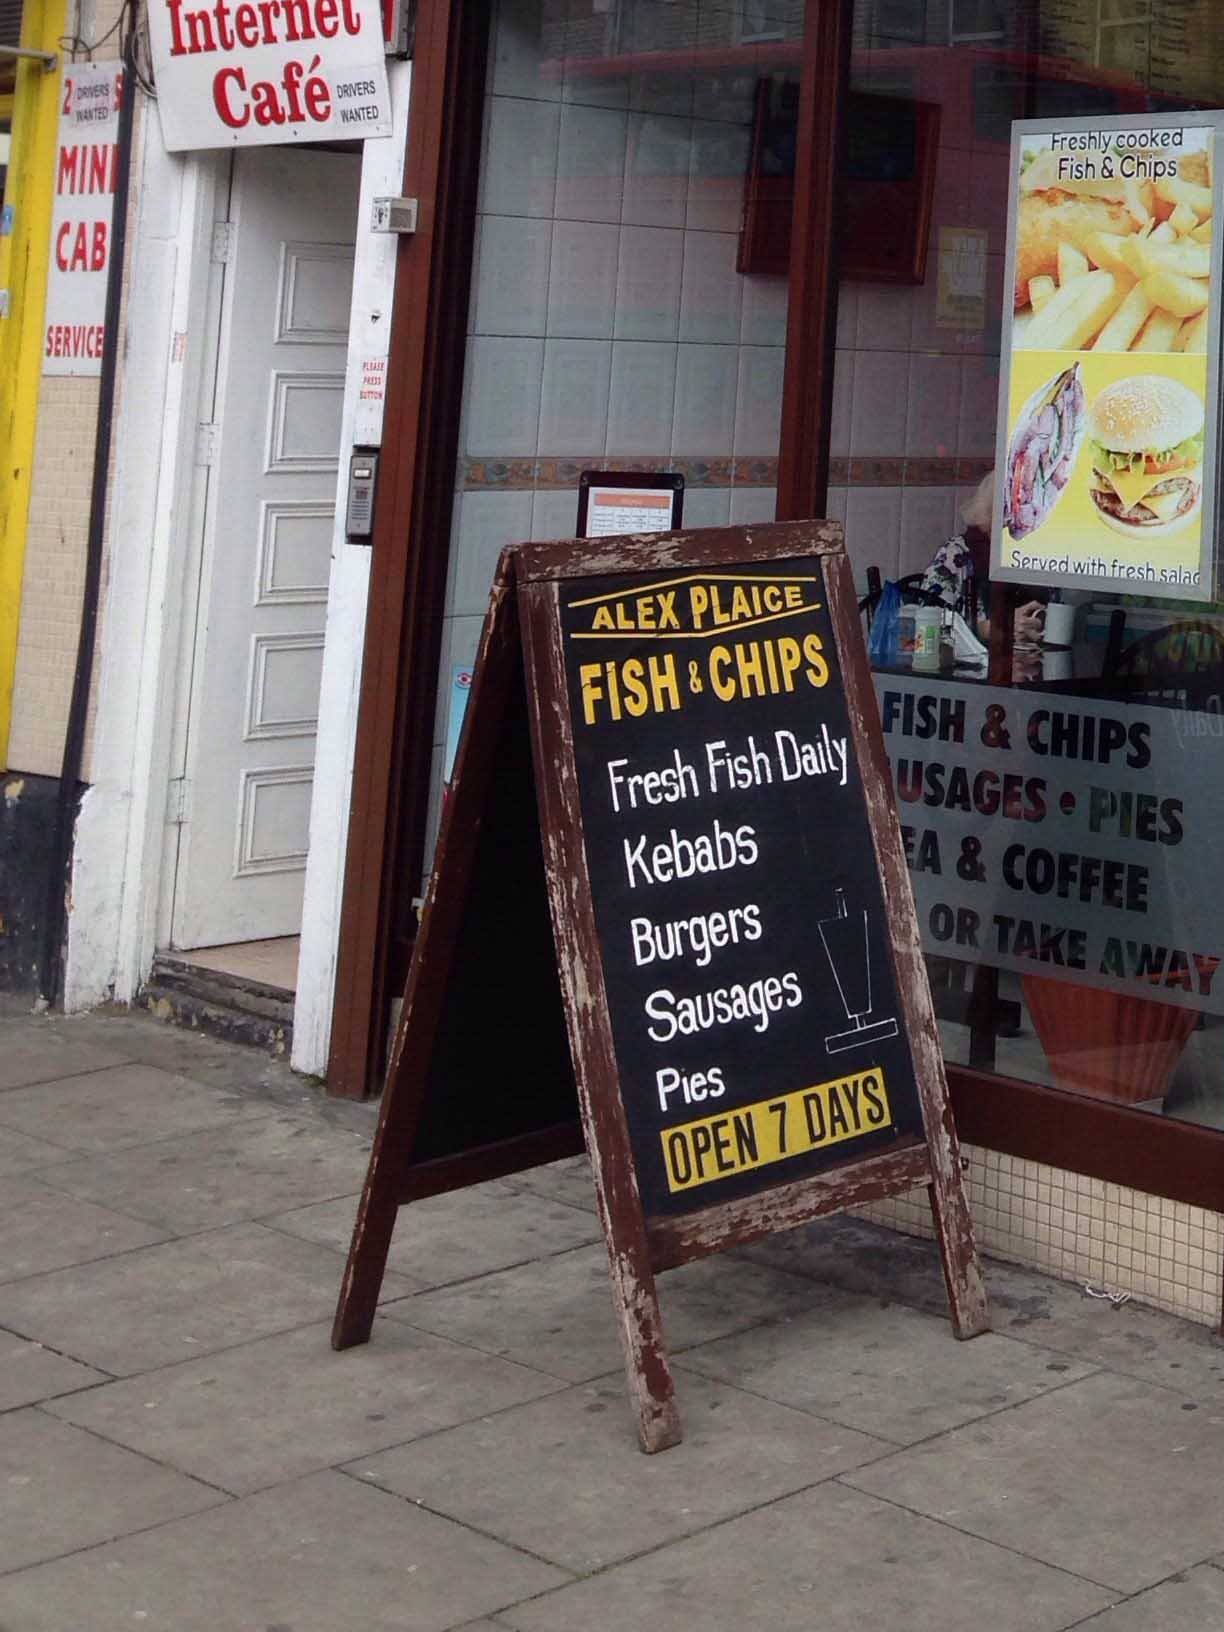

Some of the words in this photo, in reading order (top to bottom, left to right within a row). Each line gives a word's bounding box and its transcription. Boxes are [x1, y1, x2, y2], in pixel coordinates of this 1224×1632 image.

[76, 107, 109, 122] WANTED
[213, 55, 331, 128] Café
[336, 80, 376, 98] DRIVERS
[340, 107, 379, 123] WANTED
[1051, 130, 1112, 154] Freshly
[1116, 127, 1183, 148] cooked
[1058, 157, 1096, 180] Fish
[1101, 156, 1114, 179] &
[1120, 155, 1177, 182] Chips
[56, 221, 107, 272] CAB
[1011, 550, 1069, 574] Served
[1073, 556, 1106, 576] with
[1111, 559, 1156, 581] fresh
[591, 591, 681, 630] ALEX
[689, 585, 803, 629] PLAICE
[580, 654, 681, 725] FISH
[688, 660, 703, 694] &
[709, 634, 829, 702] CHIPS
[883, 691, 966, 744] FISH
[980, 703, 1012, 749] &
[1027, 709, 1151, 769] CHIPS
[608, 749, 699, 813] Fresh
[705, 735, 773, 793] Fish
[775, 724, 848, 786] Daily
[896, 758, 1047, 823] USAGES
[1088, 785, 1184, 846] PIES
[624, 819, 759, 888] Kebabs
[901, 825, 943, 875] EA
[956, 835, 986, 883] &
[1002, 843, 1149, 914] COFFEE
[630, 903, 763, 967] Burgers
[928, 903, 981, 947] OR
[993, 915, 1087, 970] TAKE
[1101, 937, 1222, 996] AWAY
[645, 971, 803, 1042] Sausages
[655, 1067, 725, 1112] Pies
[669, 1112, 759, 1184] OPEN
[769, 1102, 789, 1153] 7
[804, 1076, 885, 1145] DAYS
